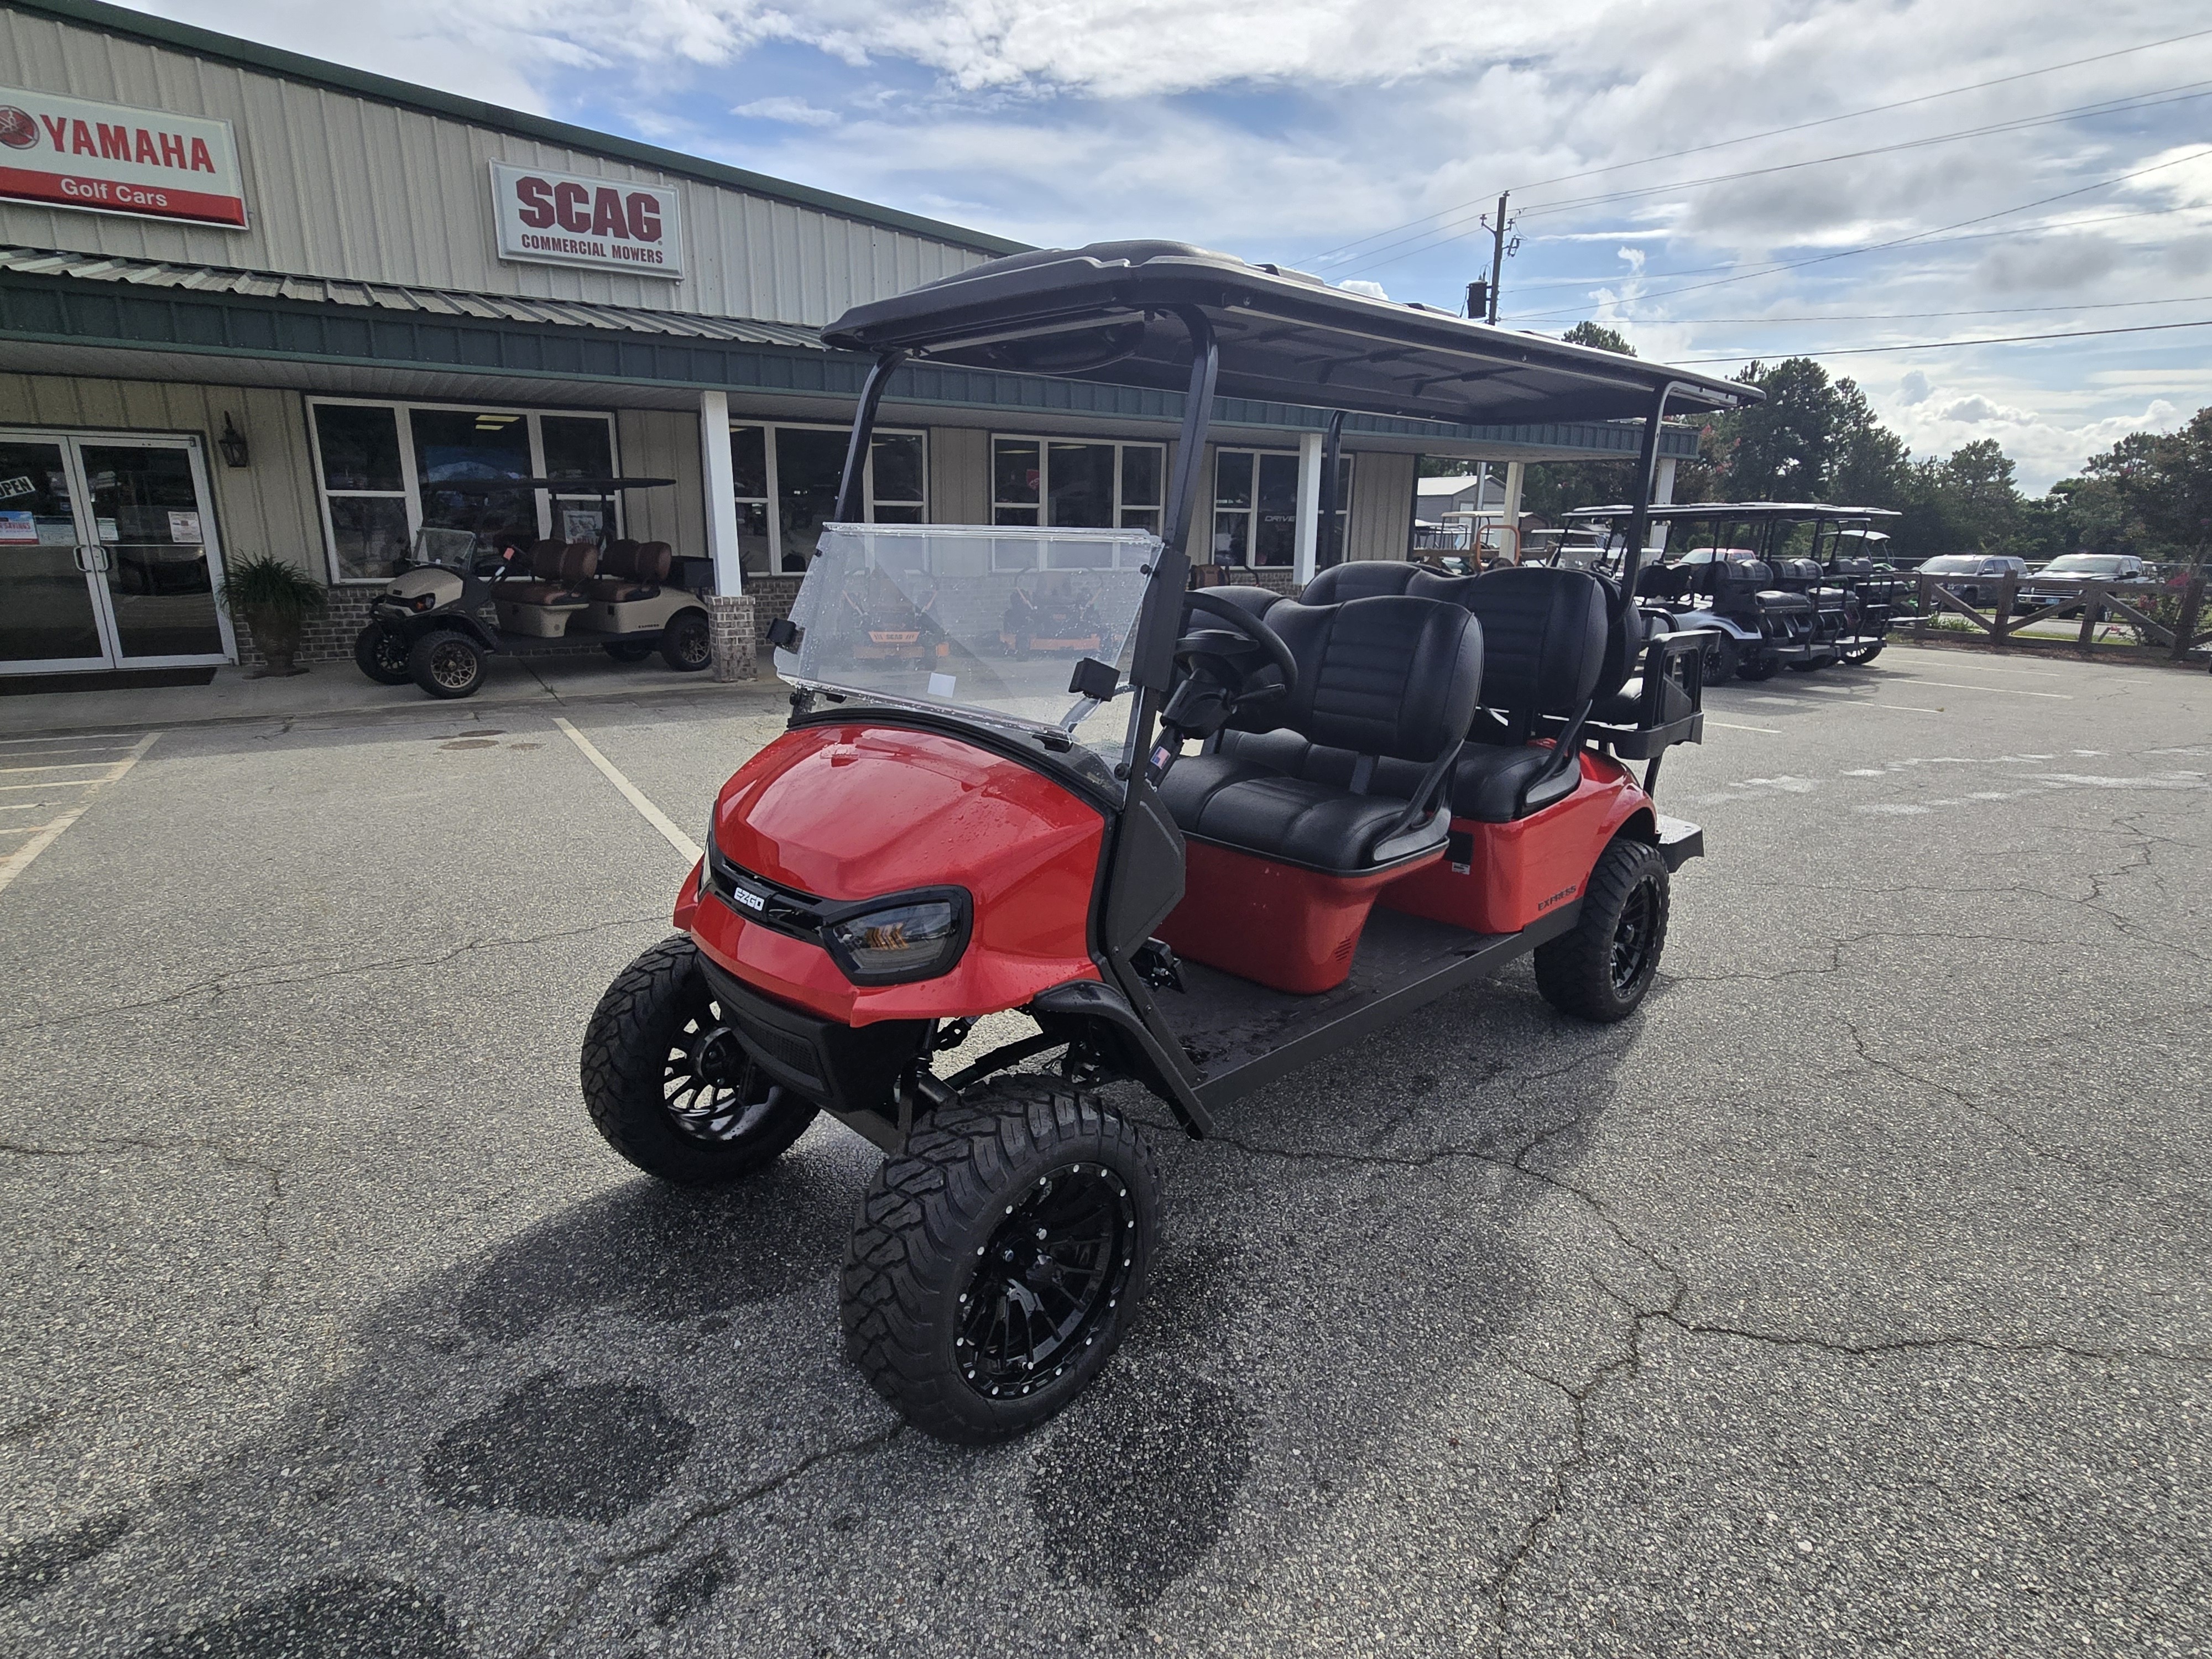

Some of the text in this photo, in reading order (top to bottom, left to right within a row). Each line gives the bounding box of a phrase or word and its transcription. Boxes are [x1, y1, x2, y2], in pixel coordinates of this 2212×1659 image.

[39, 114, 216, 174] YAMAHA
[61, 178, 168, 207] Golf Cars
[516, 176, 662, 242] SCAG
[521, 234, 663, 264] COMMERCIAL MOWERS
[734, 887, 765, 911] EZGO
[1538, 885, 1576, 911] EXPRESS
